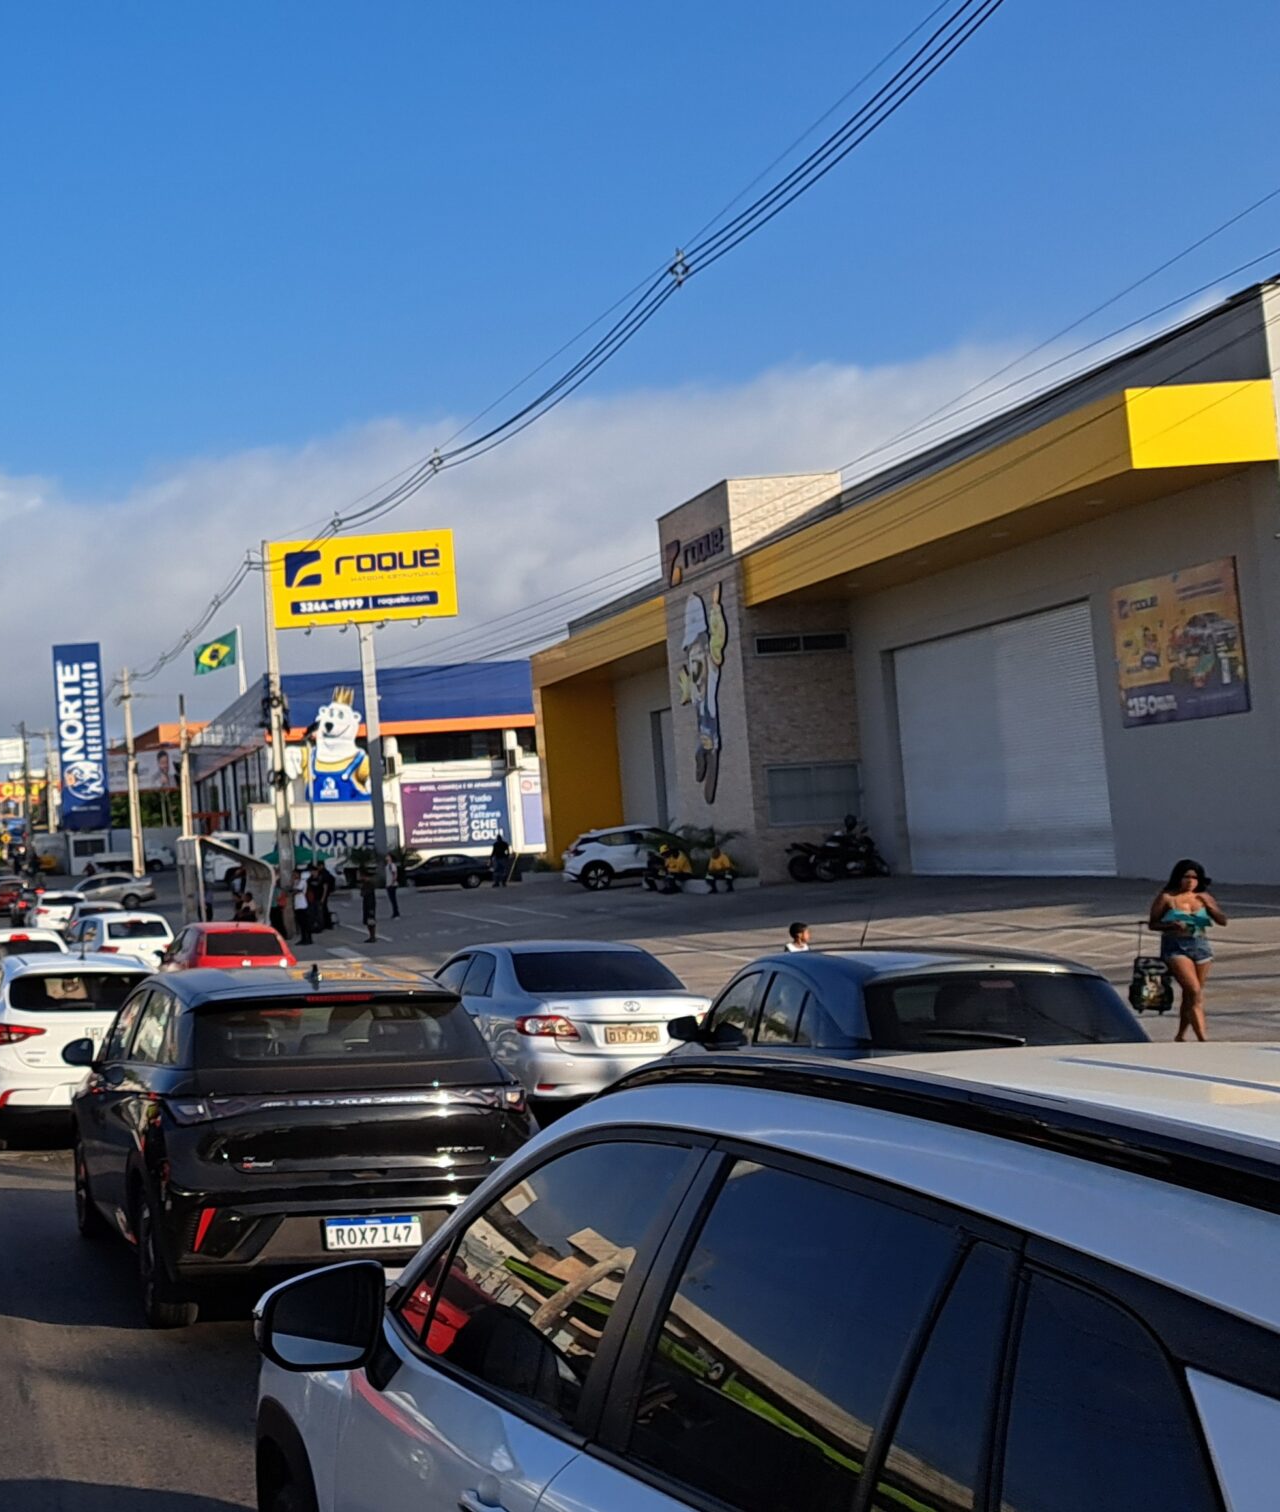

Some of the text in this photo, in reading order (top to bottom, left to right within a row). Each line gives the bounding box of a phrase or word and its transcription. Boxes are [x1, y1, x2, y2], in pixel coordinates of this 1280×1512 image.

[683, 527, 725, 569] roque
[335, 548, 440, 575] roque
[300, 598, 364, 613] 3244-8999
[56, 660, 85, 762] NORTE
[469, 794, 492, 802] Tudo
[469, 803, 487, 811] que
[471, 818, 497, 830] CHE
[298, 829, 375, 848] NORTE
